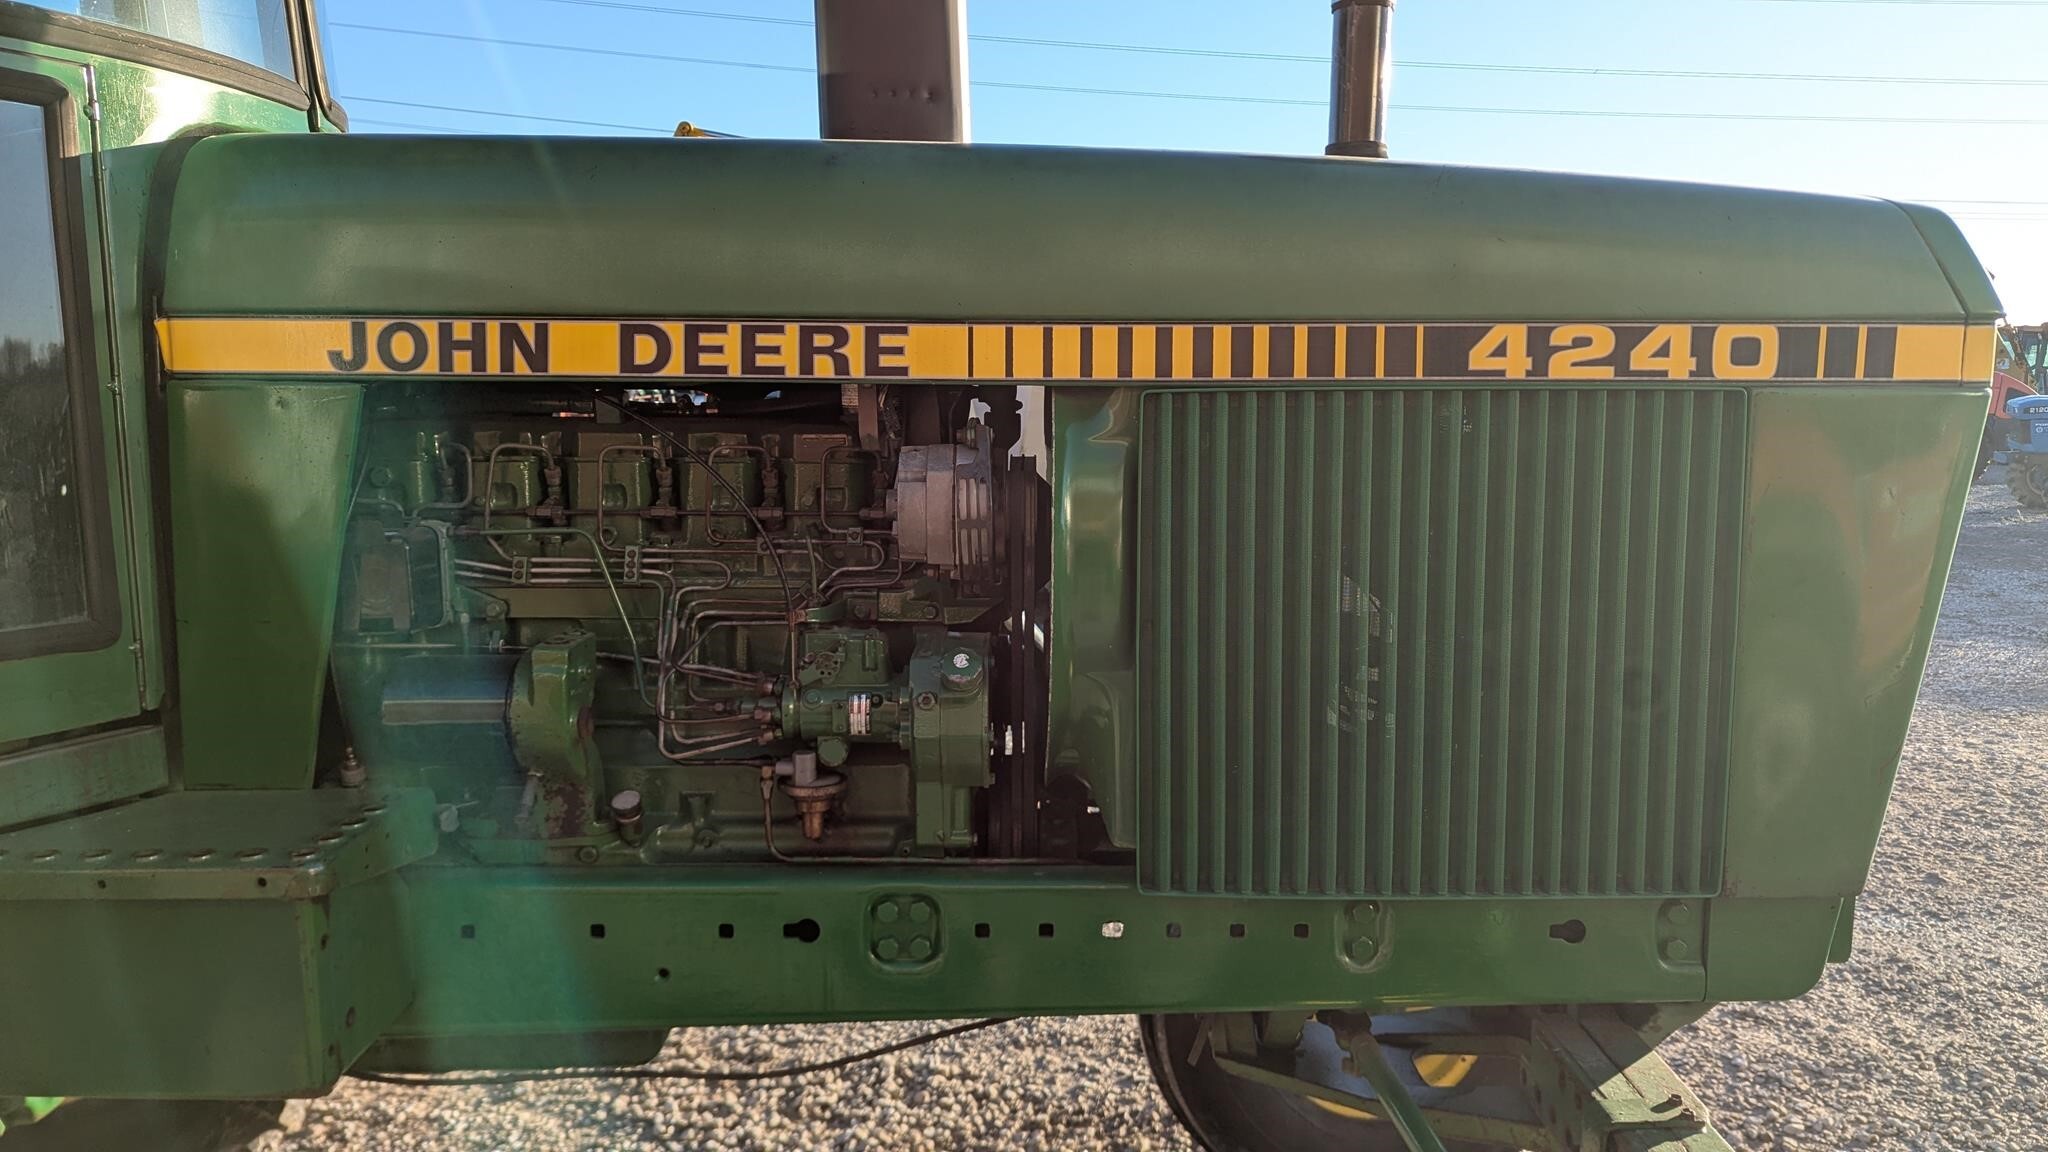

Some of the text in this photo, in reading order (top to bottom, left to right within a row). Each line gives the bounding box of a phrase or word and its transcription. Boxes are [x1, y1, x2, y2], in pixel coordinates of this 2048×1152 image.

[327, 321, 909, 376] JOHN DEERE
[1468, 323, 1779, 380] 4240
